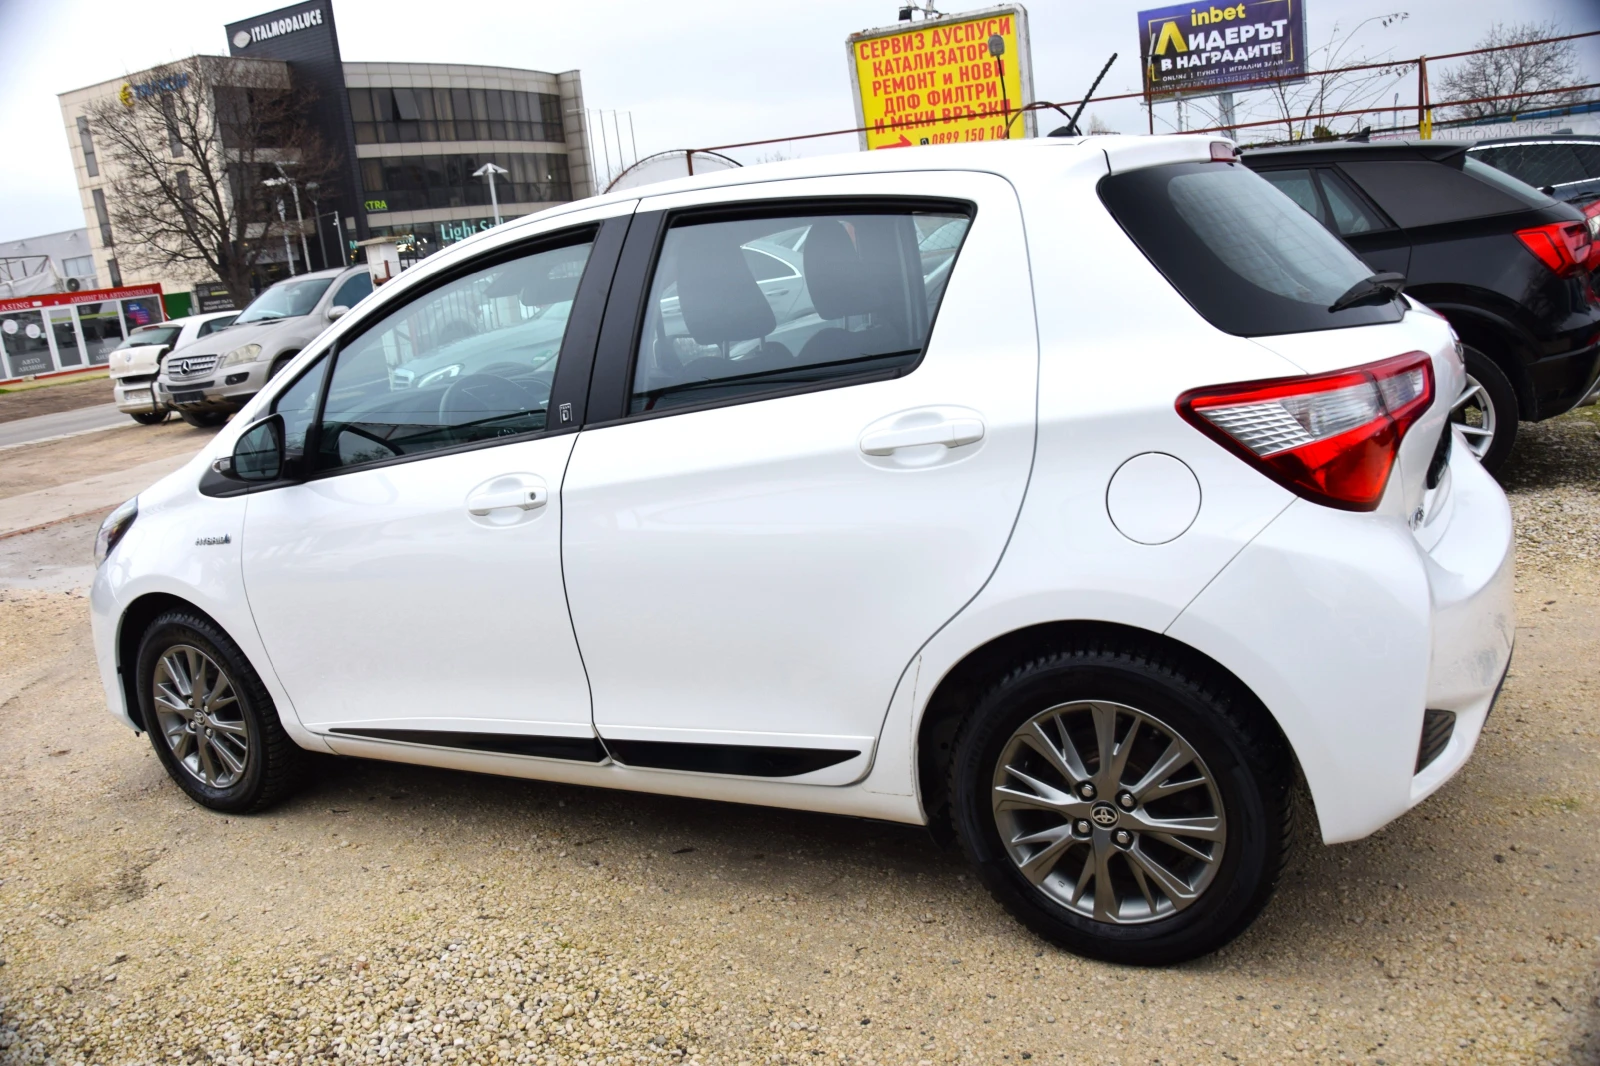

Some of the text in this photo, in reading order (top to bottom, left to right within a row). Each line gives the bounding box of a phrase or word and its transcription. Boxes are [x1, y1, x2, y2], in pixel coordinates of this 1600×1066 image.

[251, 9, 322, 42] ITALMODALUCE
[1191, 3, 1246, 26] inbet
[860, 17, 1011, 60] СЕРВИЗ АУСПУСИ
[1154, 19, 1287, 55] ЛИДЕРЪТ
[873, 42, 998, 77] КАТАЛИЗАТОР
[1161, 42, 1282, 71] В НАГРАДИТЕ
[872, 71, 936, 96] РЕМОНТ
[959, 60, 1005, 83] НОВИ
[884, 81, 998, 117] ДПФ ФИЛТРИ
[891, 109, 936, 132] МЕКИ
[942, 99, 1012, 124] ВРЪЗКИ
[932, 131, 959, 145] 0899
[965, 127, 985, 142] 150
[440, 220, 477, 242] Light
[98, 292, 108, 301] НА
[21, 357, 41, 366] АВТО
